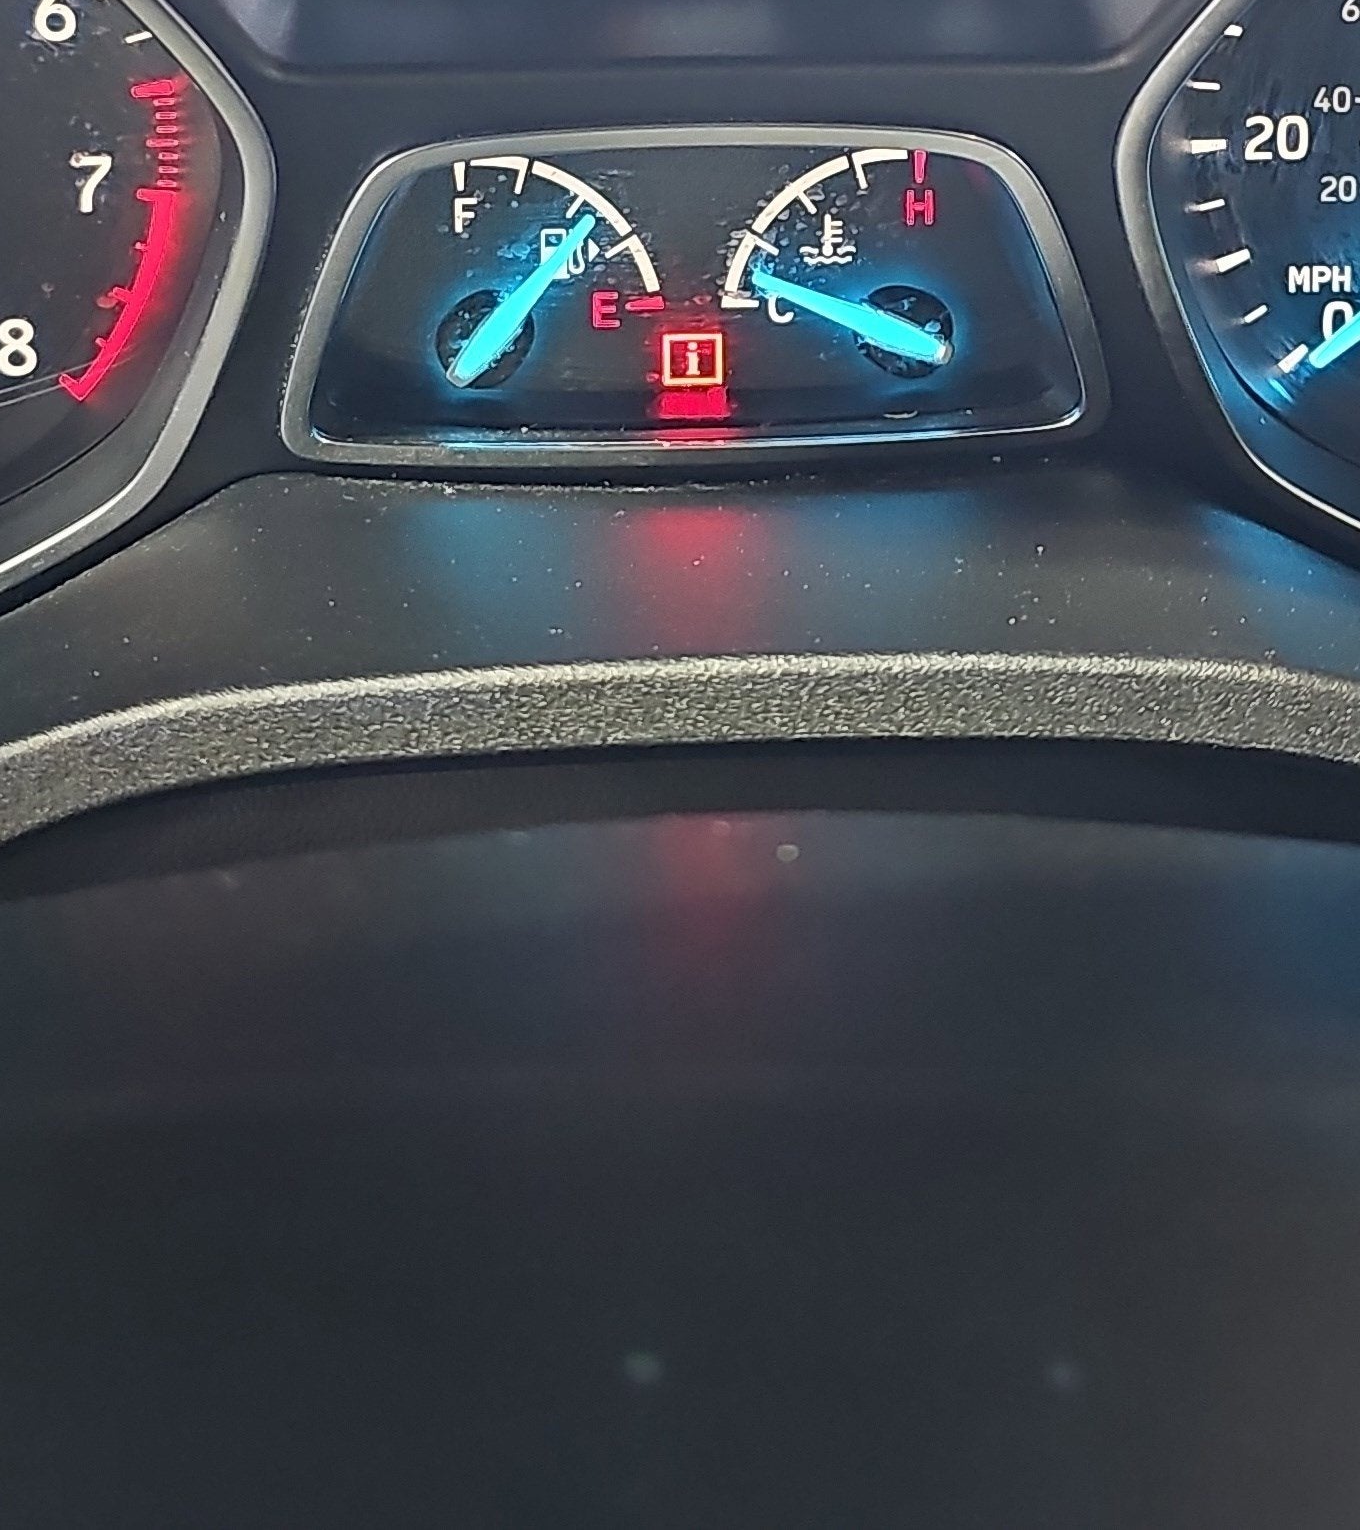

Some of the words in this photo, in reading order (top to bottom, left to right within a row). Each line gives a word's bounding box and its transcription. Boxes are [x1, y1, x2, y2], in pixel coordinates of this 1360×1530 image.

[1313, 88, 1352, 113] 40
[1244, 114, 1311, 161] 20
[70, 153, 113, 213] 7
[1320, 176, 1357, 203] 20
[454, 196, 478, 233] F
[905, 189, 934, 227] H
[1288, 265, 1351, 293] MPH
[591, 292, 618, 328] E
[1321, 300, 1355, 341] 0
